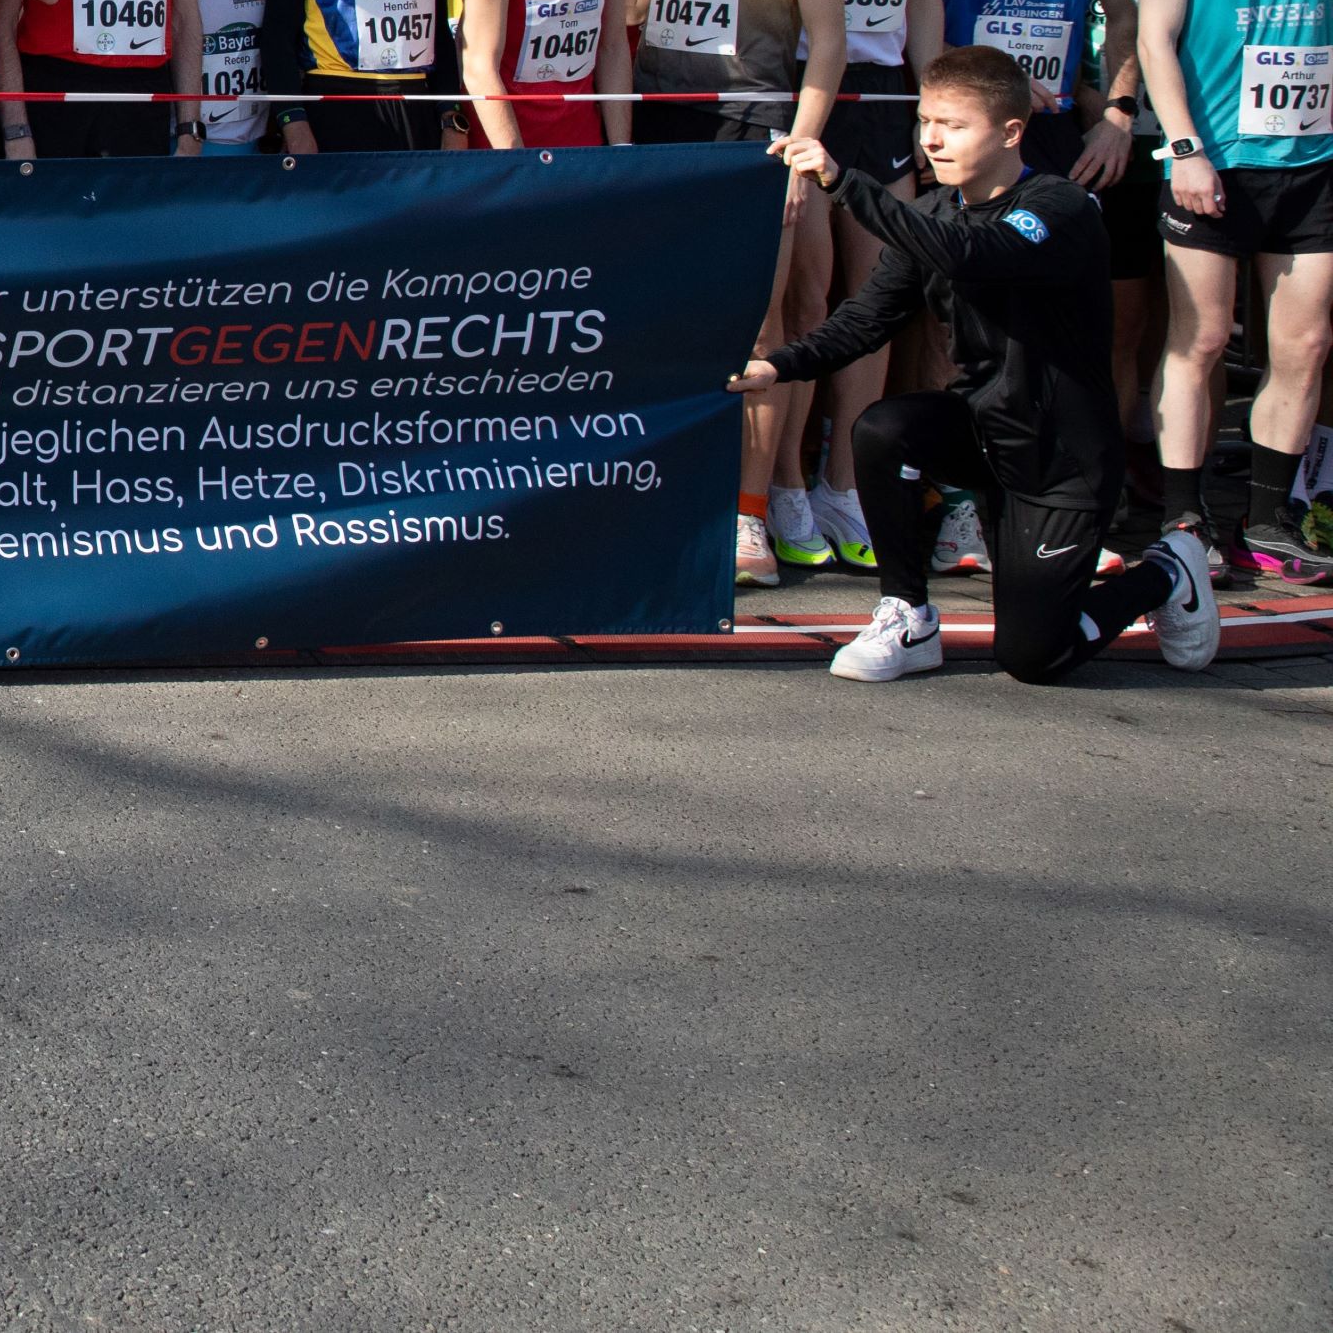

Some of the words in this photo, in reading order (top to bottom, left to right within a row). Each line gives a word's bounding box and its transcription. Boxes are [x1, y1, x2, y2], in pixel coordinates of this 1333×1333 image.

[81, 0, 165, 28] 10466
[383, 0, 418, 11] Hendrik
[1004, 7, 1064, 19] TÜBINGEN
[1235, 2, 1326, 26] ENGELS
[364, 13, 433, 44] 10457
[560, 20, 579, 29] Tom
[218, 33, 256, 51] Bayer
[530, 27, 598, 60] 10467
[1007, 39, 1045, 52] Lorenz
[224, 55, 251, 66] Recep
[1018, 54, 1061, 80] 800
[1281, 71, 1316, 80] Arthur
[1250, 83, 1330, 110] 10737
[21, 275, 293, 313] unterstützen
[306, 271, 370, 304] die
[381, 265, 593, 305] Kampagne
[12, 374, 271, 407] distanzieren
[284, 373, 358, 401] uns
[370, 365, 615, 398] entschieden
[198, 411, 559, 453] Ausdrucksformen
[568, 408, 647, 441] von
[71, 470, 186, 508] Hass,
[197, 466, 328, 503] Hetze,
[339, 456, 664, 500] Diskriminierung,
[195, 516, 281, 553] und
[291, 509, 511, 548] Rassismus.
